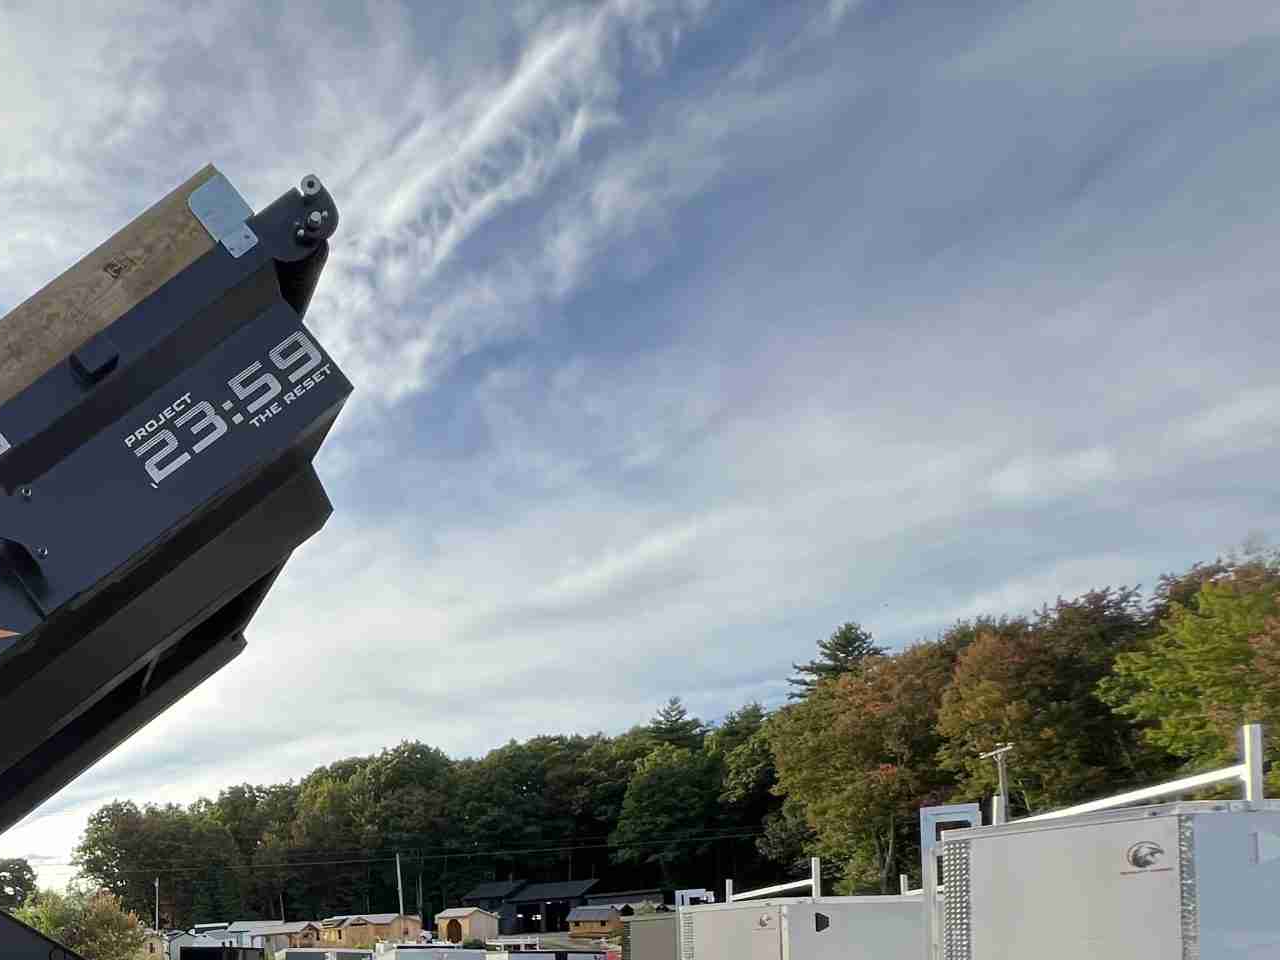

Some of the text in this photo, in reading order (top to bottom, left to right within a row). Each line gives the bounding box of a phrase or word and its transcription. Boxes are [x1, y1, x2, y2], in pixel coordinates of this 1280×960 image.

[124, 391, 193, 447] PROJECT
[133, 330, 322, 484] 23:59
[249, 363, 332, 427] THE RESET
